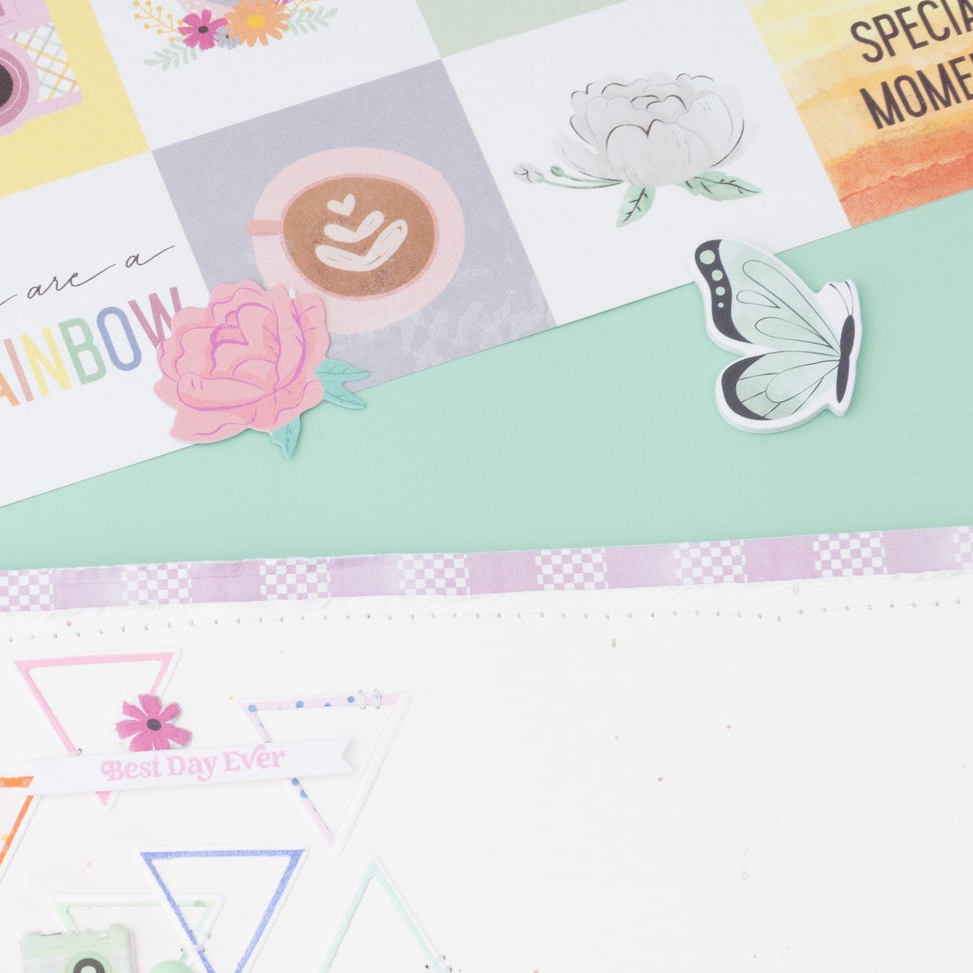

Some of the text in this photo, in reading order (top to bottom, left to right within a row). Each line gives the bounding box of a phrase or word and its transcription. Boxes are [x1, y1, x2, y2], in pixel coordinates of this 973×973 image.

[859, 53, 973, 129] MOME
[27, 264, 116, 300] are
[126, 245, 175, 268] a
[100, 744, 285, 782] Best Day Ever
